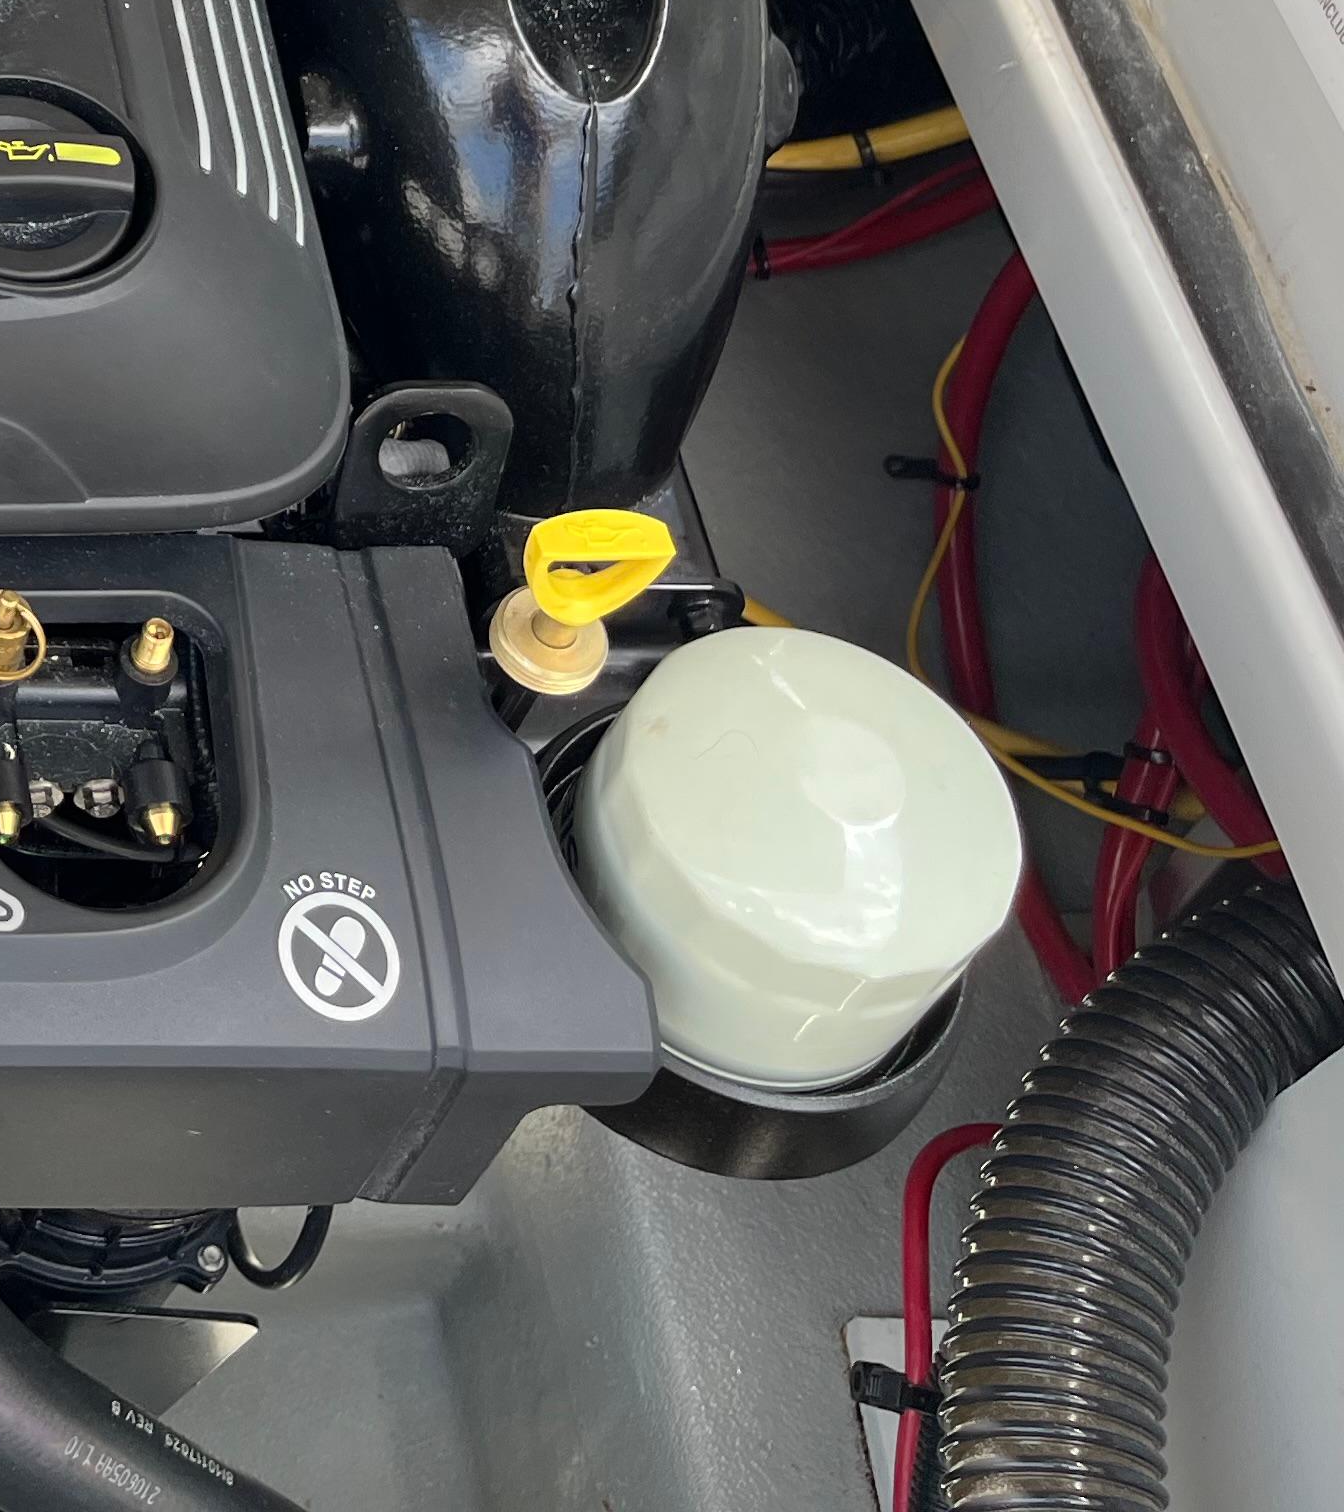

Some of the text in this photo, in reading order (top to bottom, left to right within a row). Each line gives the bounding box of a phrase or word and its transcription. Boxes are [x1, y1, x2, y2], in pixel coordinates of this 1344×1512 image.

[282, 871, 376, 900] NO STEP
[125, 1409, 153, 1435] REV
